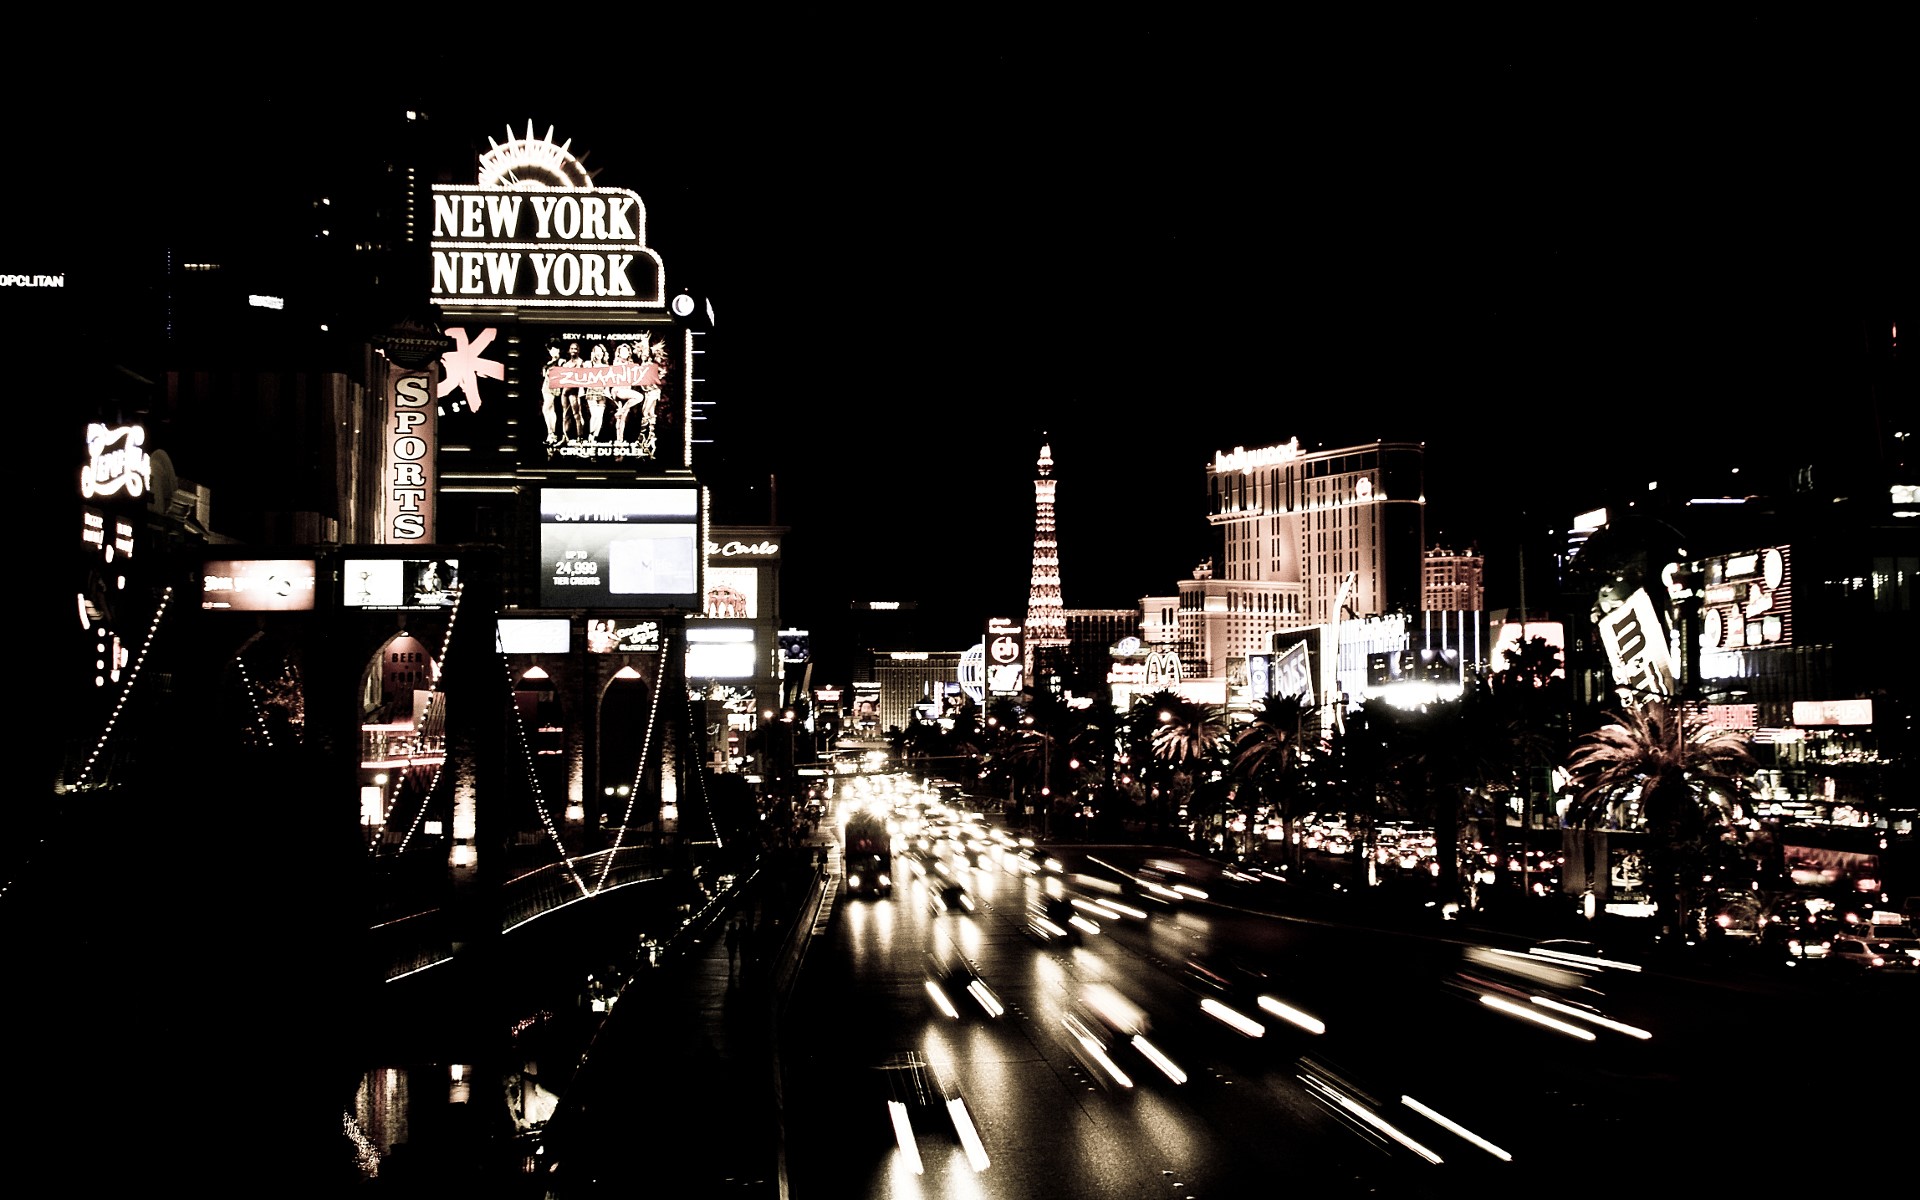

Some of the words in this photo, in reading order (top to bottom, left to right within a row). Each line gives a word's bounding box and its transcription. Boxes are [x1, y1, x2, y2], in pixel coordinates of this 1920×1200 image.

[432, 195, 523, 238] NEW
[529, 196, 636, 240] YORK
[431, 251, 522, 295] NEW
[528, 253, 636, 296] YORK
[559, 366, 650, 386] ZUMANITY
[393, 376, 430, 540] SPORTS
[560, 447, 596, 458] CIRQUE
[597, 448, 612, 456] DU
[577, 551, 587, 559] TO
[721, 540, 779, 556] Carlo
[555, 561, 598, 576] 24,999
[391, 652, 423, 662] BEER
